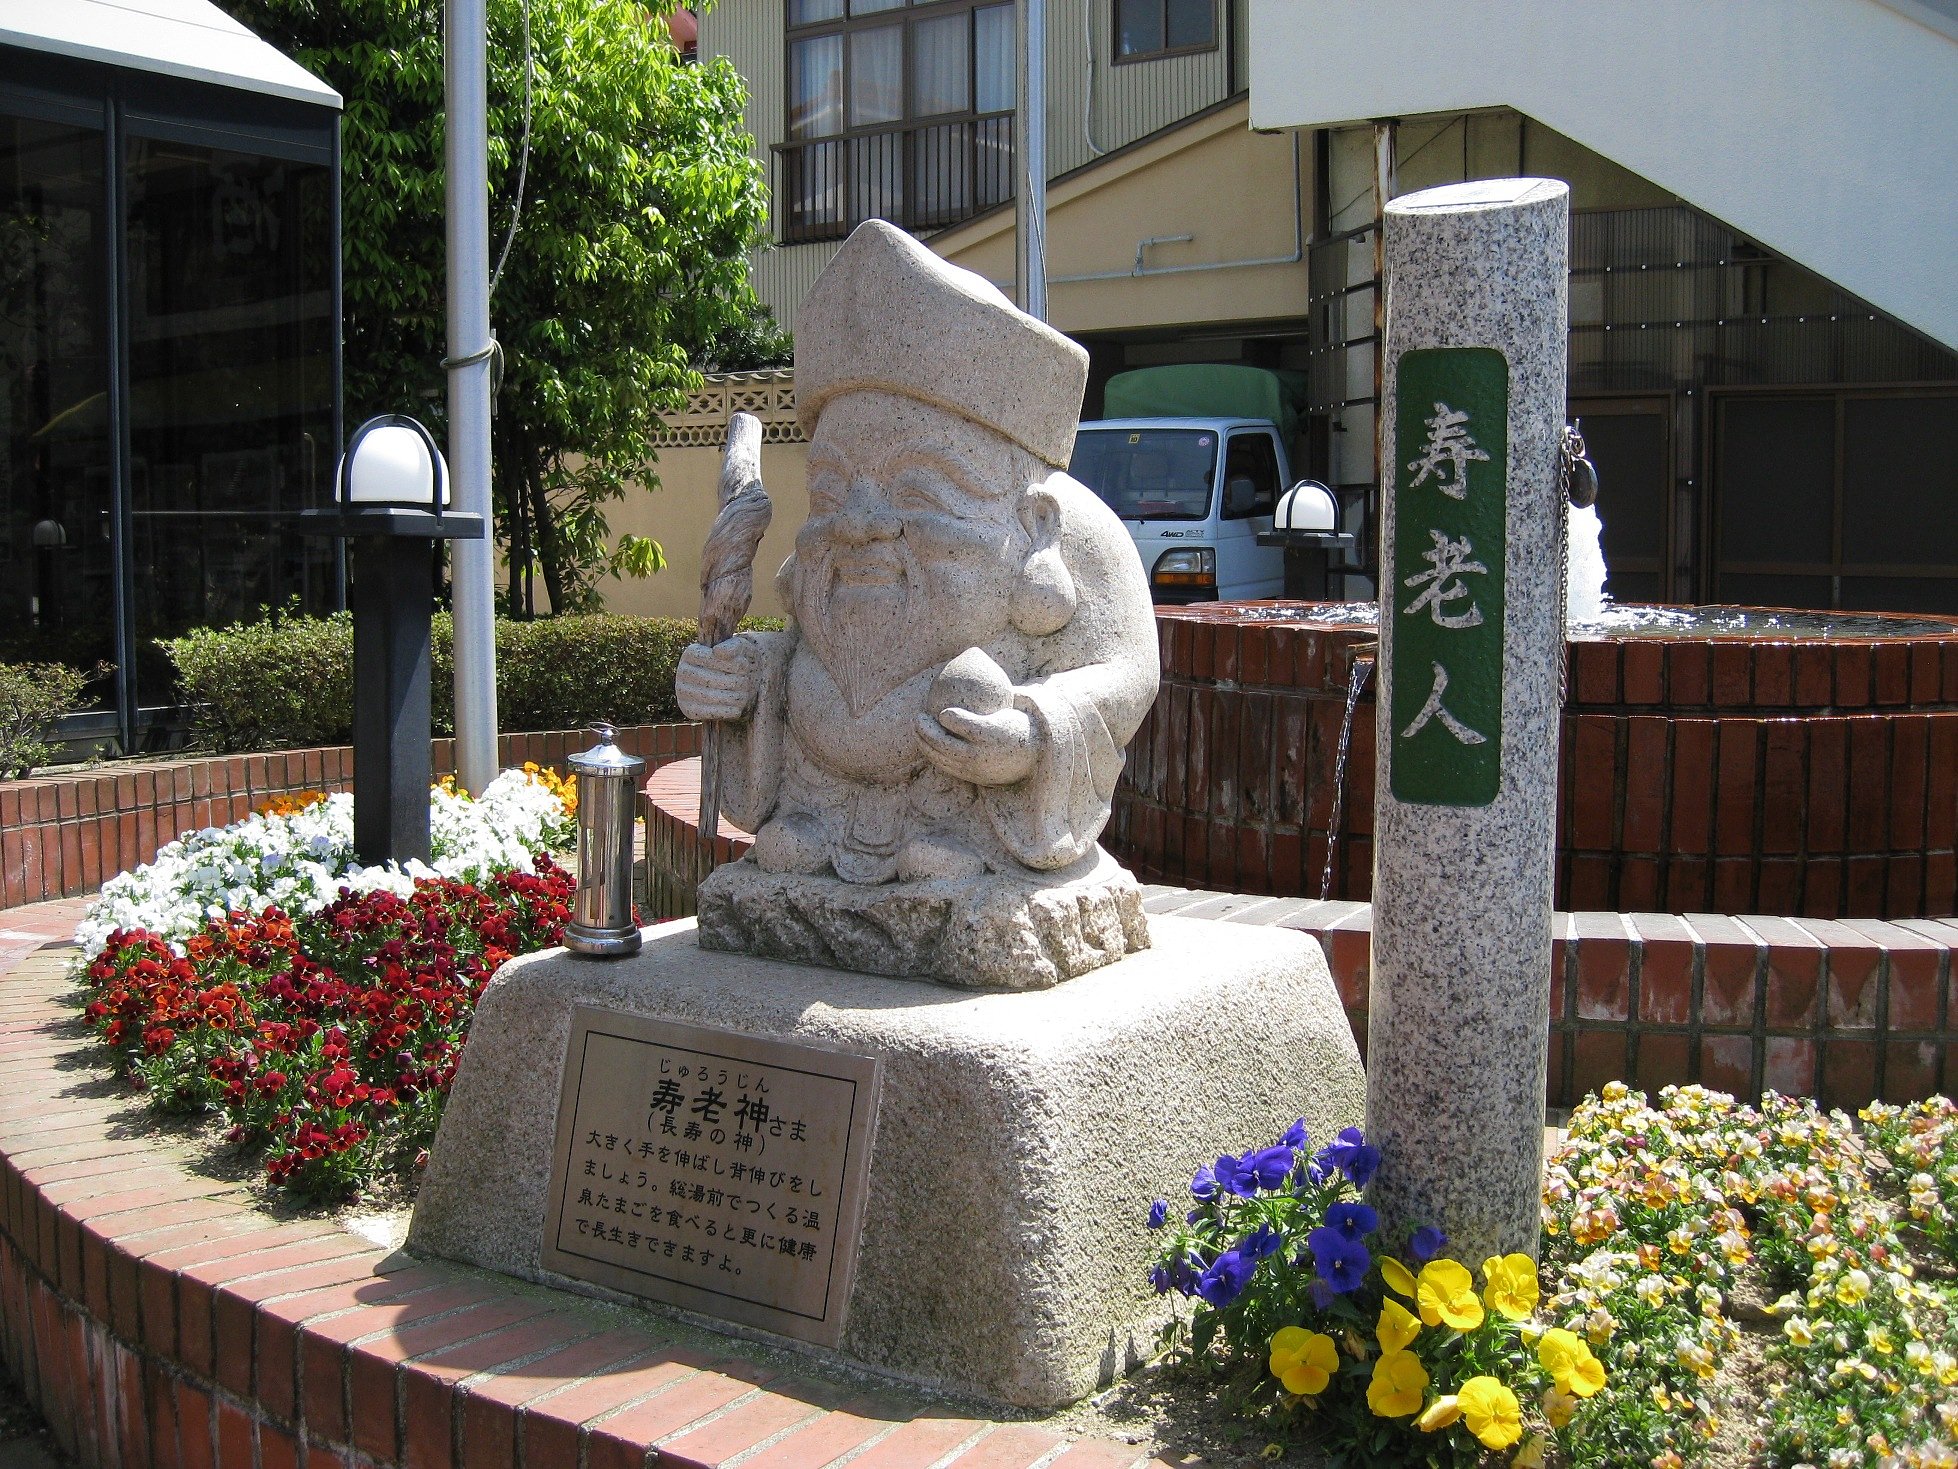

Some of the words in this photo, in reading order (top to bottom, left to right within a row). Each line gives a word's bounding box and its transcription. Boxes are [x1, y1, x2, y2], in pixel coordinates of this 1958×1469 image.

[1401, 401, 1491, 746] 寿老人
[659, 1057, 770, 1094] じゅろうじん
[650, 1078, 807, 1143] 寿老神さま
[584, 1159, 820, 1231] ましょう。総湯前でつくる温
[586, 1130, 823, 1197] 大きく手を伸ばし背伸びをし
[576, 1216, 742, 1276] で長生きできますよ。
[578, 1187, 817, 1262] 泉たまごを食べると更に健康
